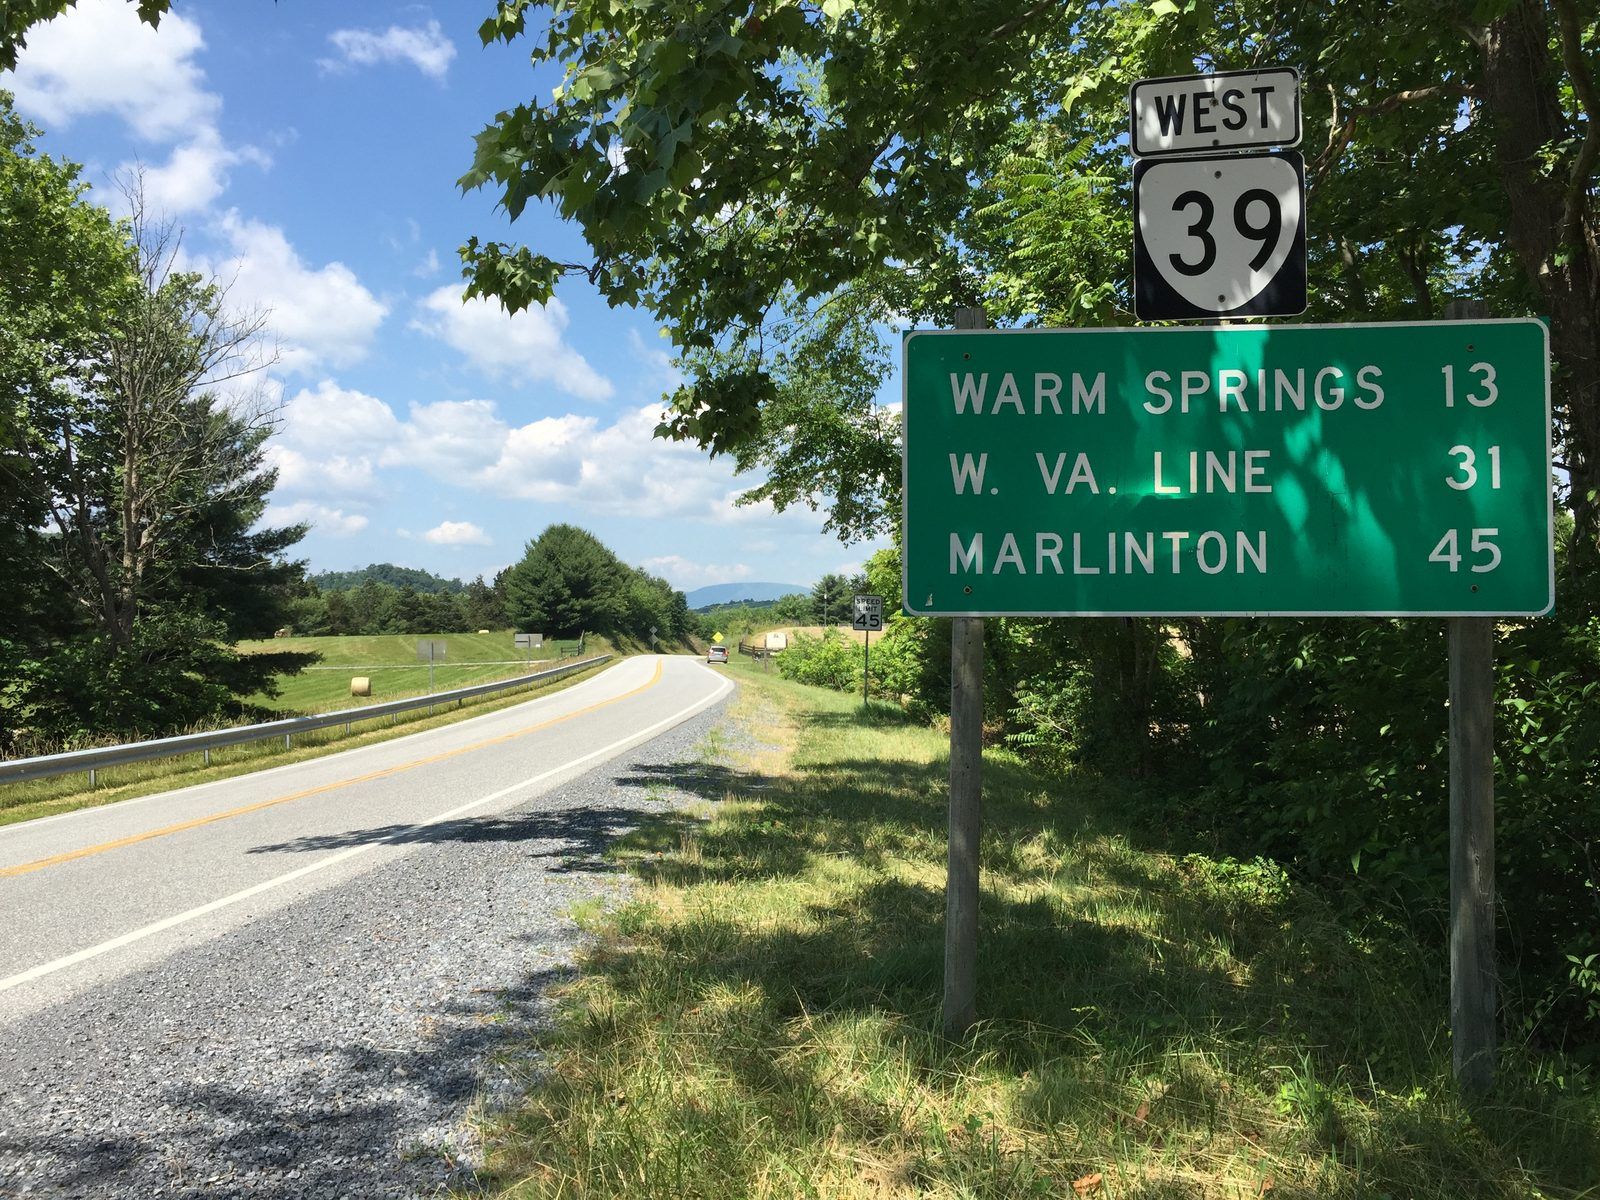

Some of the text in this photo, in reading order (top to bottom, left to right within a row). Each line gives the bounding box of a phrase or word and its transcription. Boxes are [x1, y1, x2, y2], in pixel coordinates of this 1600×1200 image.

[1154, 86, 1275, 137] WEST
[1168, 188, 1282, 277] 39
[950, 362, 1499, 415] WARM SPRINGS 13
[949, 445, 1501, 495] W. VA. LINE 31
[949, 528, 1502, 575] MARLINTON 45
[855, 614, 880, 627] 45
